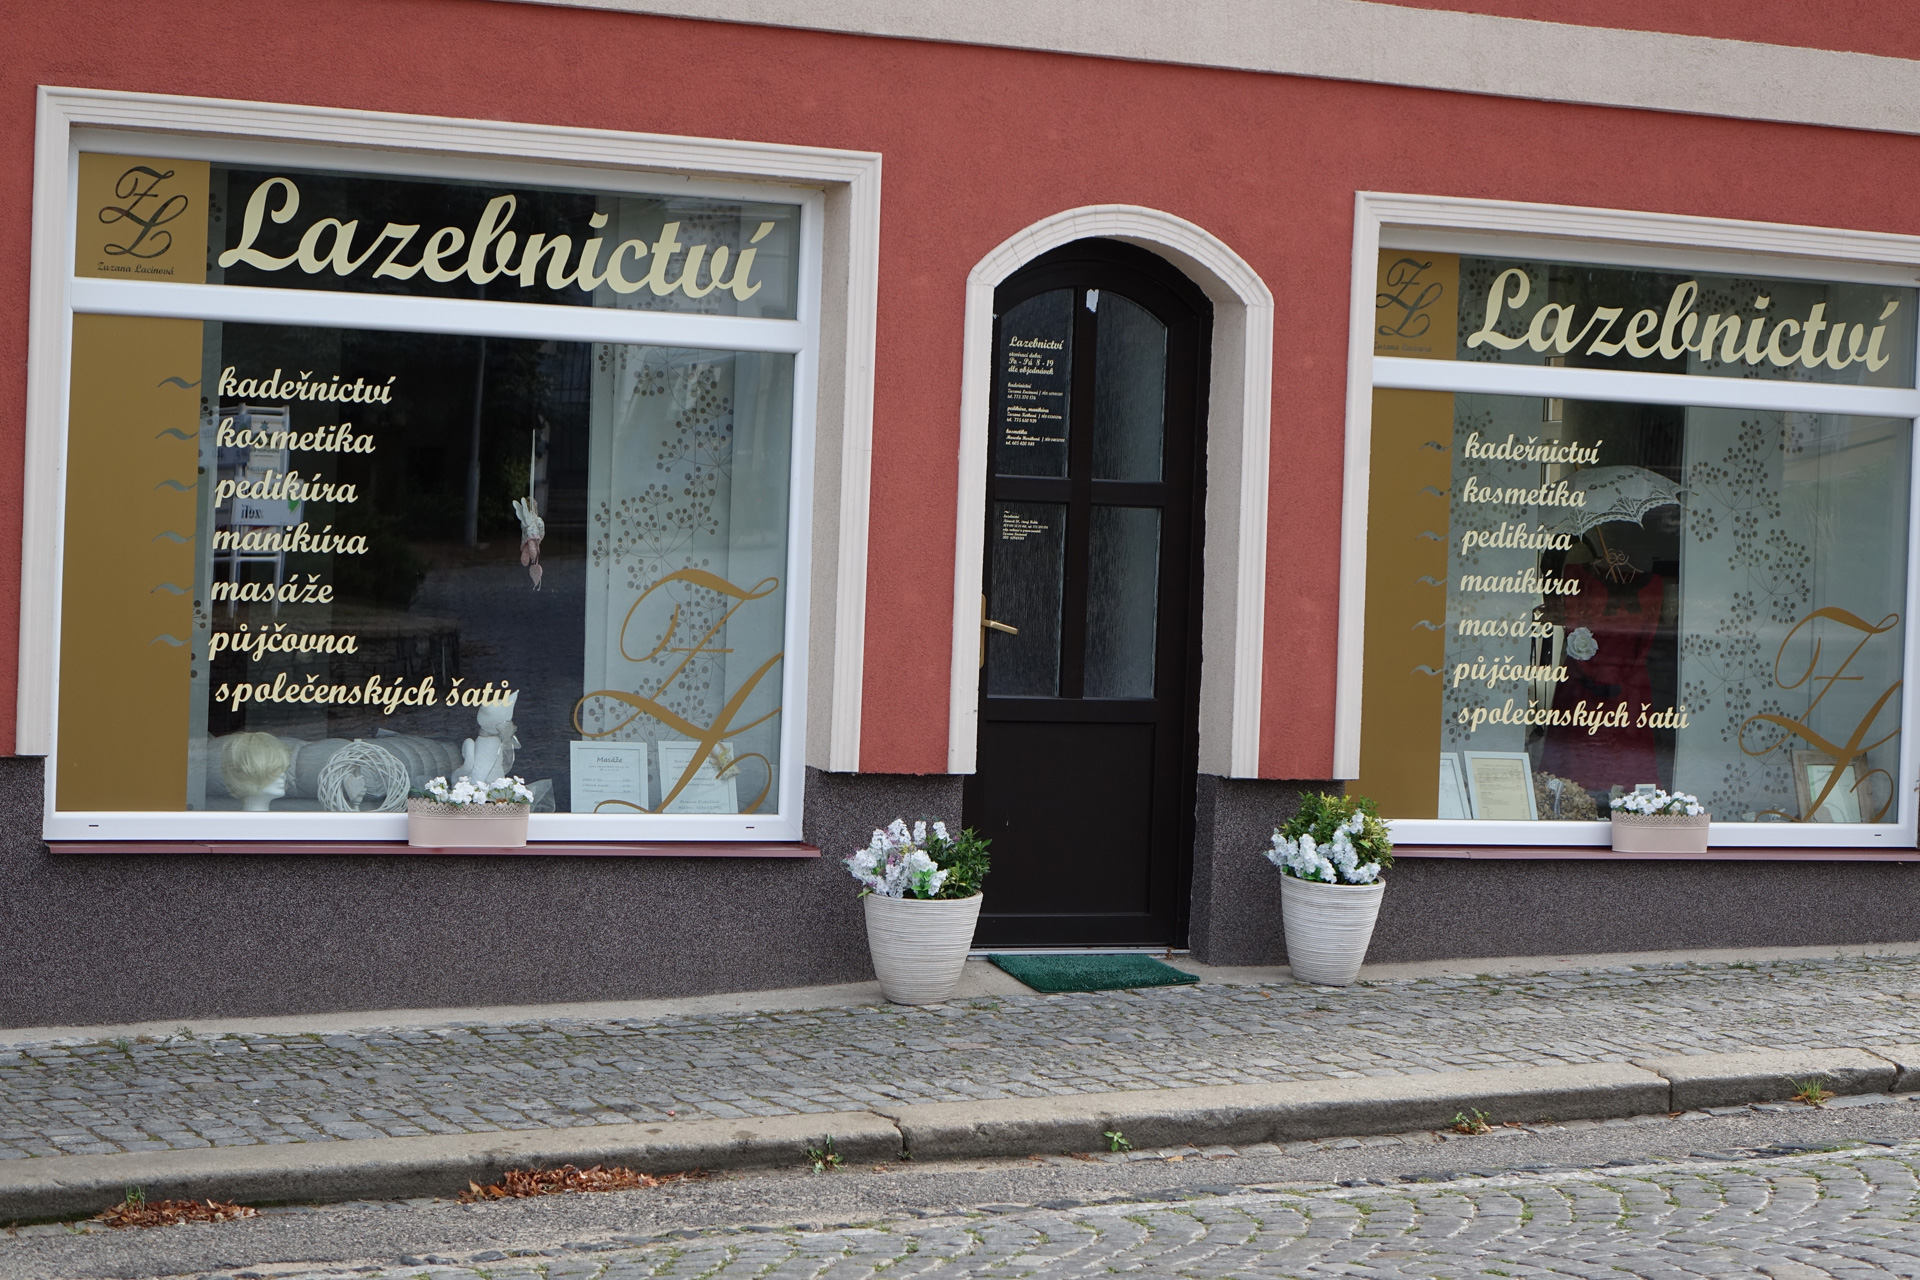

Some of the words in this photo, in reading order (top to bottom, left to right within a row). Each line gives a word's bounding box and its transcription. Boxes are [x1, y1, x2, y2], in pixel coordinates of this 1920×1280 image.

[218, 177, 775, 301] Lazebnictví
[97, 261, 131, 273] Zuzana
[134, 263, 174, 276] Lacinová
[1467, 268, 1899, 373] Lazebnictví
[1009, 335, 1064, 350] Lazebnictví
[1008, 365, 1018, 373] dle
[1036, 359, 1041, 367] 8
[1046, 359, 1054, 367] 19
[217, 366, 395, 404] kadeřnictví
[216, 416, 376, 454] kosmetika
[1464, 431, 1603, 464] kadeřnictví
[214, 469, 358, 507] pedikúra
[1462, 475, 1587, 508] kosmetika
[212, 522, 369, 555] manikúra
[1461, 521, 1573, 556] pedikúra
[210, 574, 334, 604] masáže
[1459, 566, 1581, 596] manikúra
[1458, 610, 1554, 638] masáže
[208, 621, 358, 662] půjčovna
[1452, 655, 1569, 689] půjčovna
[214, 672, 438, 715] společenských
[445, 677, 514, 708] šatů
[1457, 700, 1631, 736] společenských
[1635, 704, 1690, 731] šatů
[596, 756, 623, 765] Masáže
